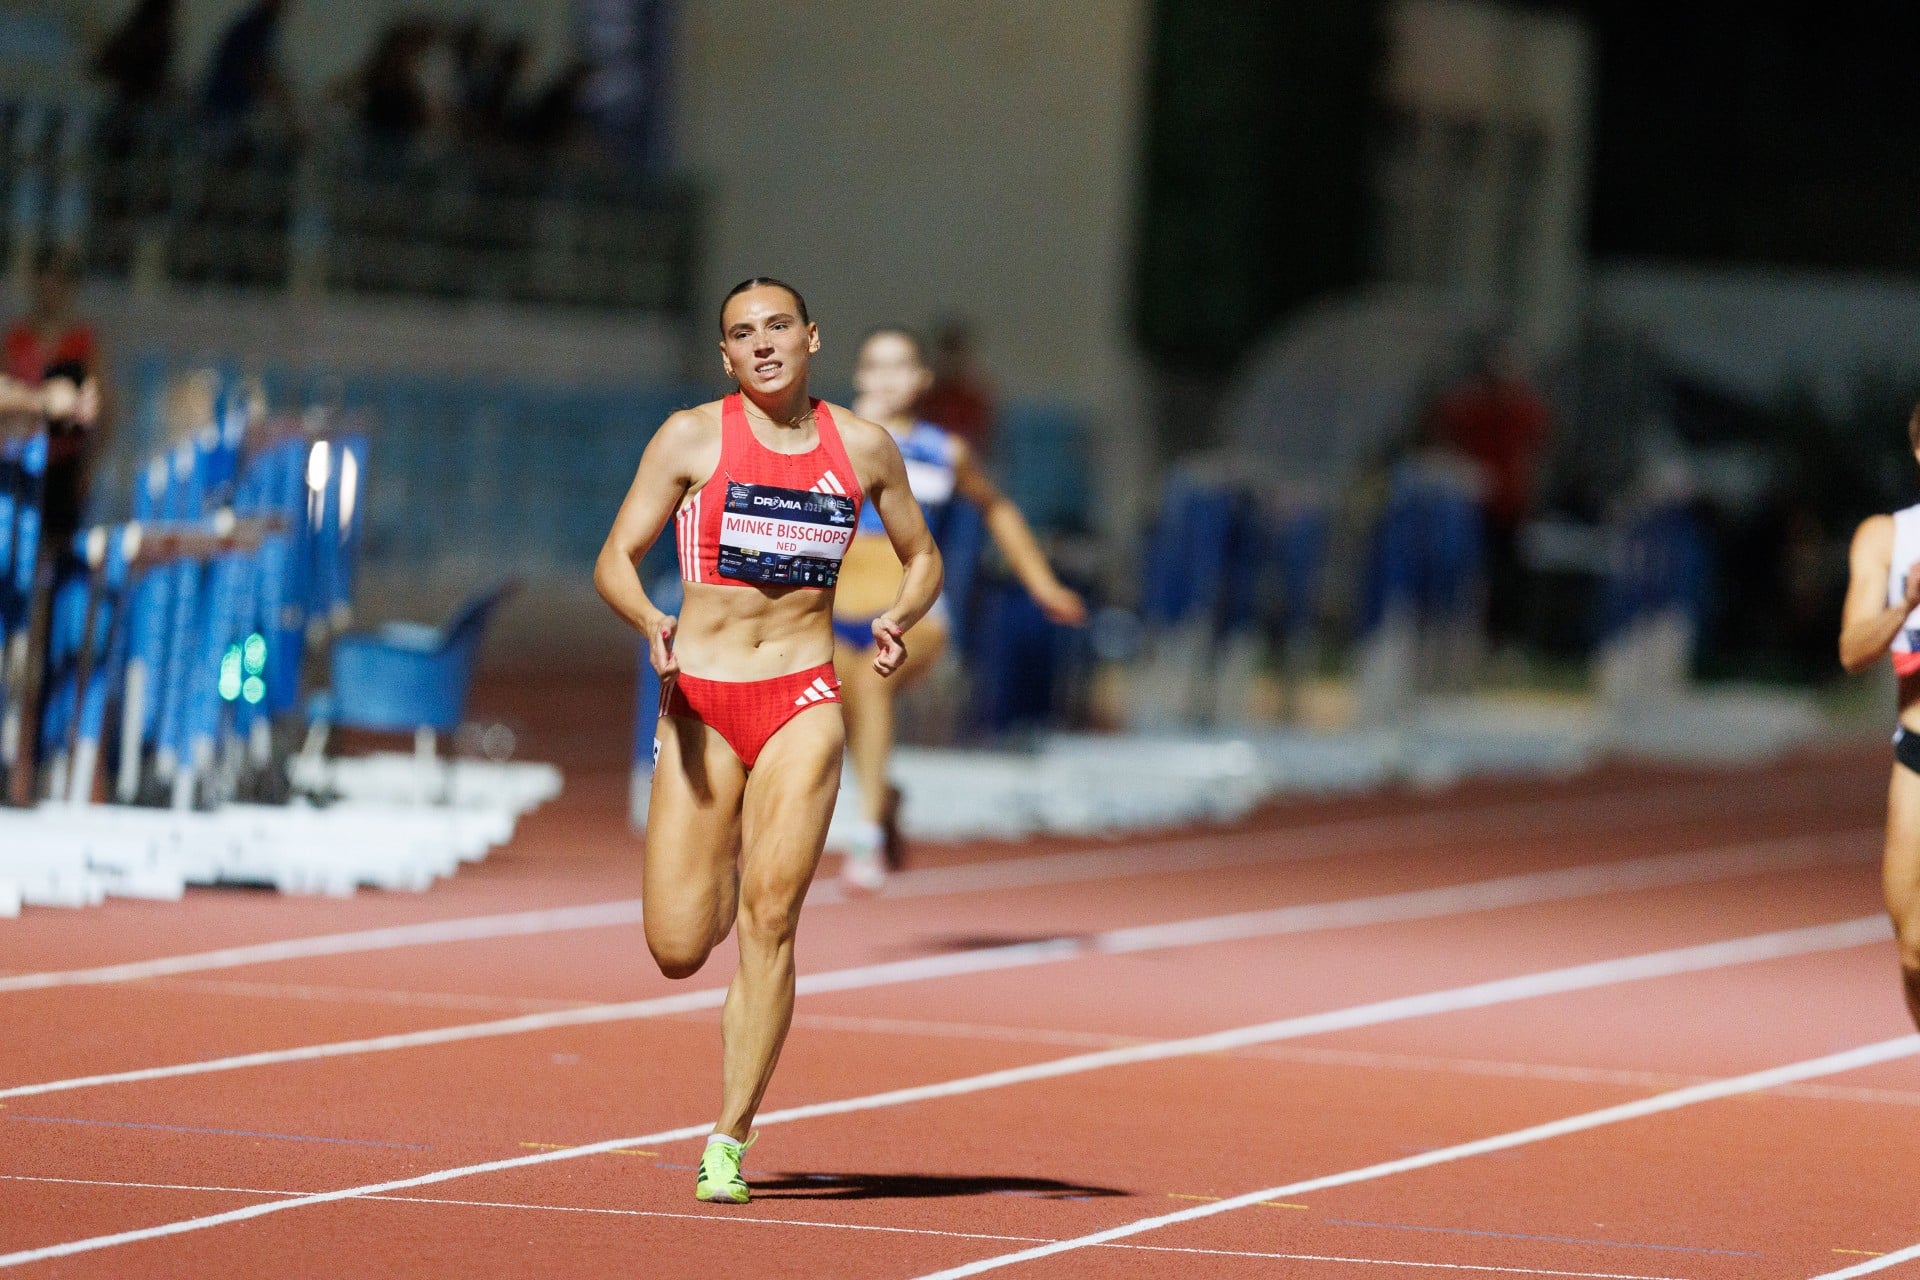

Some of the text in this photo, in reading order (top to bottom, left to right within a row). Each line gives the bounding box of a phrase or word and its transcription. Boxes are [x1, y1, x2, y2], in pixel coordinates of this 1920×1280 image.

[753, 496, 801, 510] DROMIA
[726, 517, 847, 545] MINKE BISSCHOPS
[776, 541, 797, 552] NED
